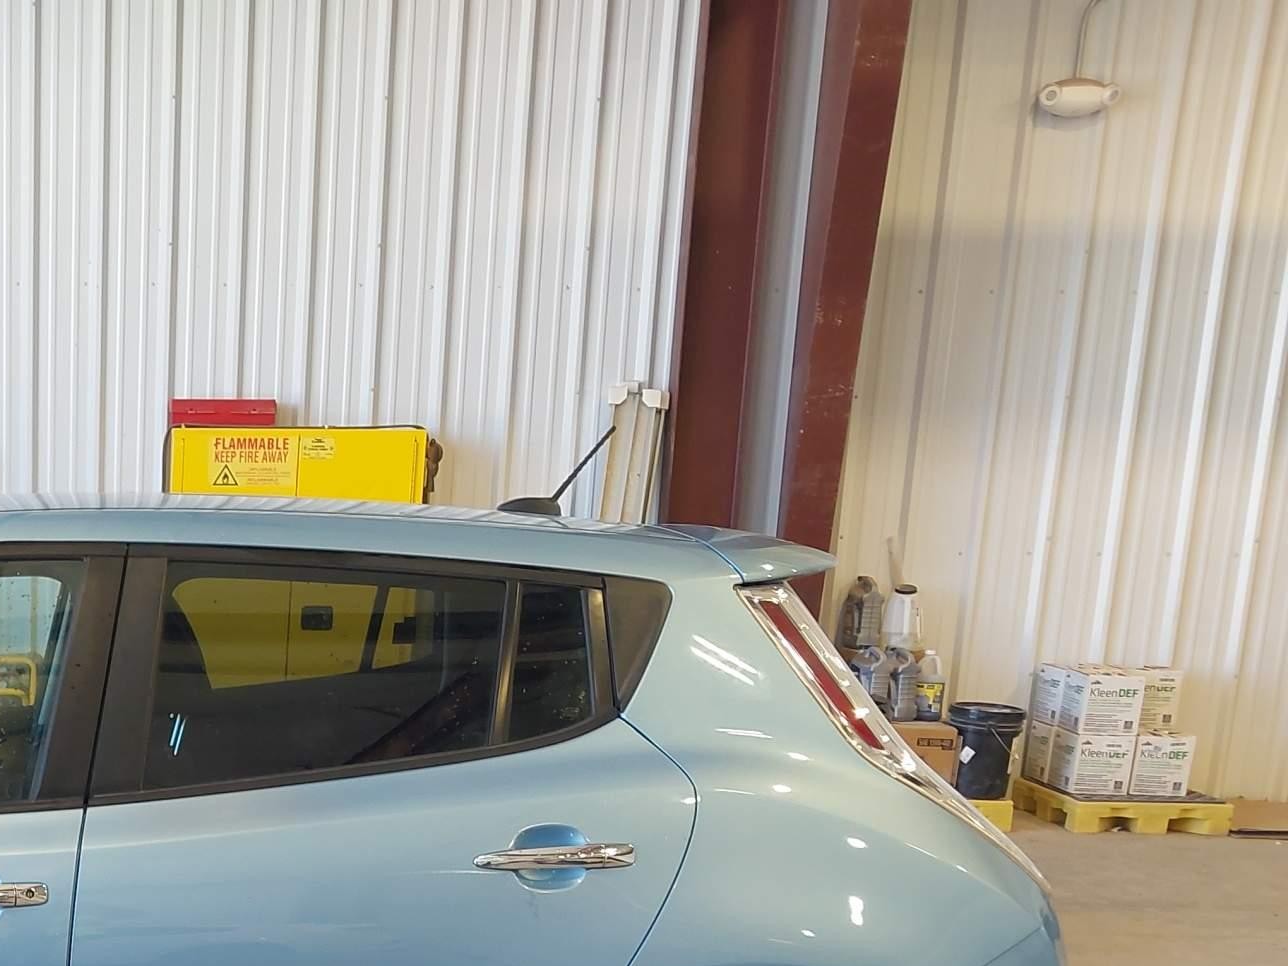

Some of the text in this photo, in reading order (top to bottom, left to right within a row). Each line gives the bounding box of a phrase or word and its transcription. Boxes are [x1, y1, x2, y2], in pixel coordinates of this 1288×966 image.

[214, 437, 289, 450] FLAMMABLE
[214, 450, 289, 463] KEEP FIRE AWAY
[1089, 688, 1140, 698] KleenDEF
